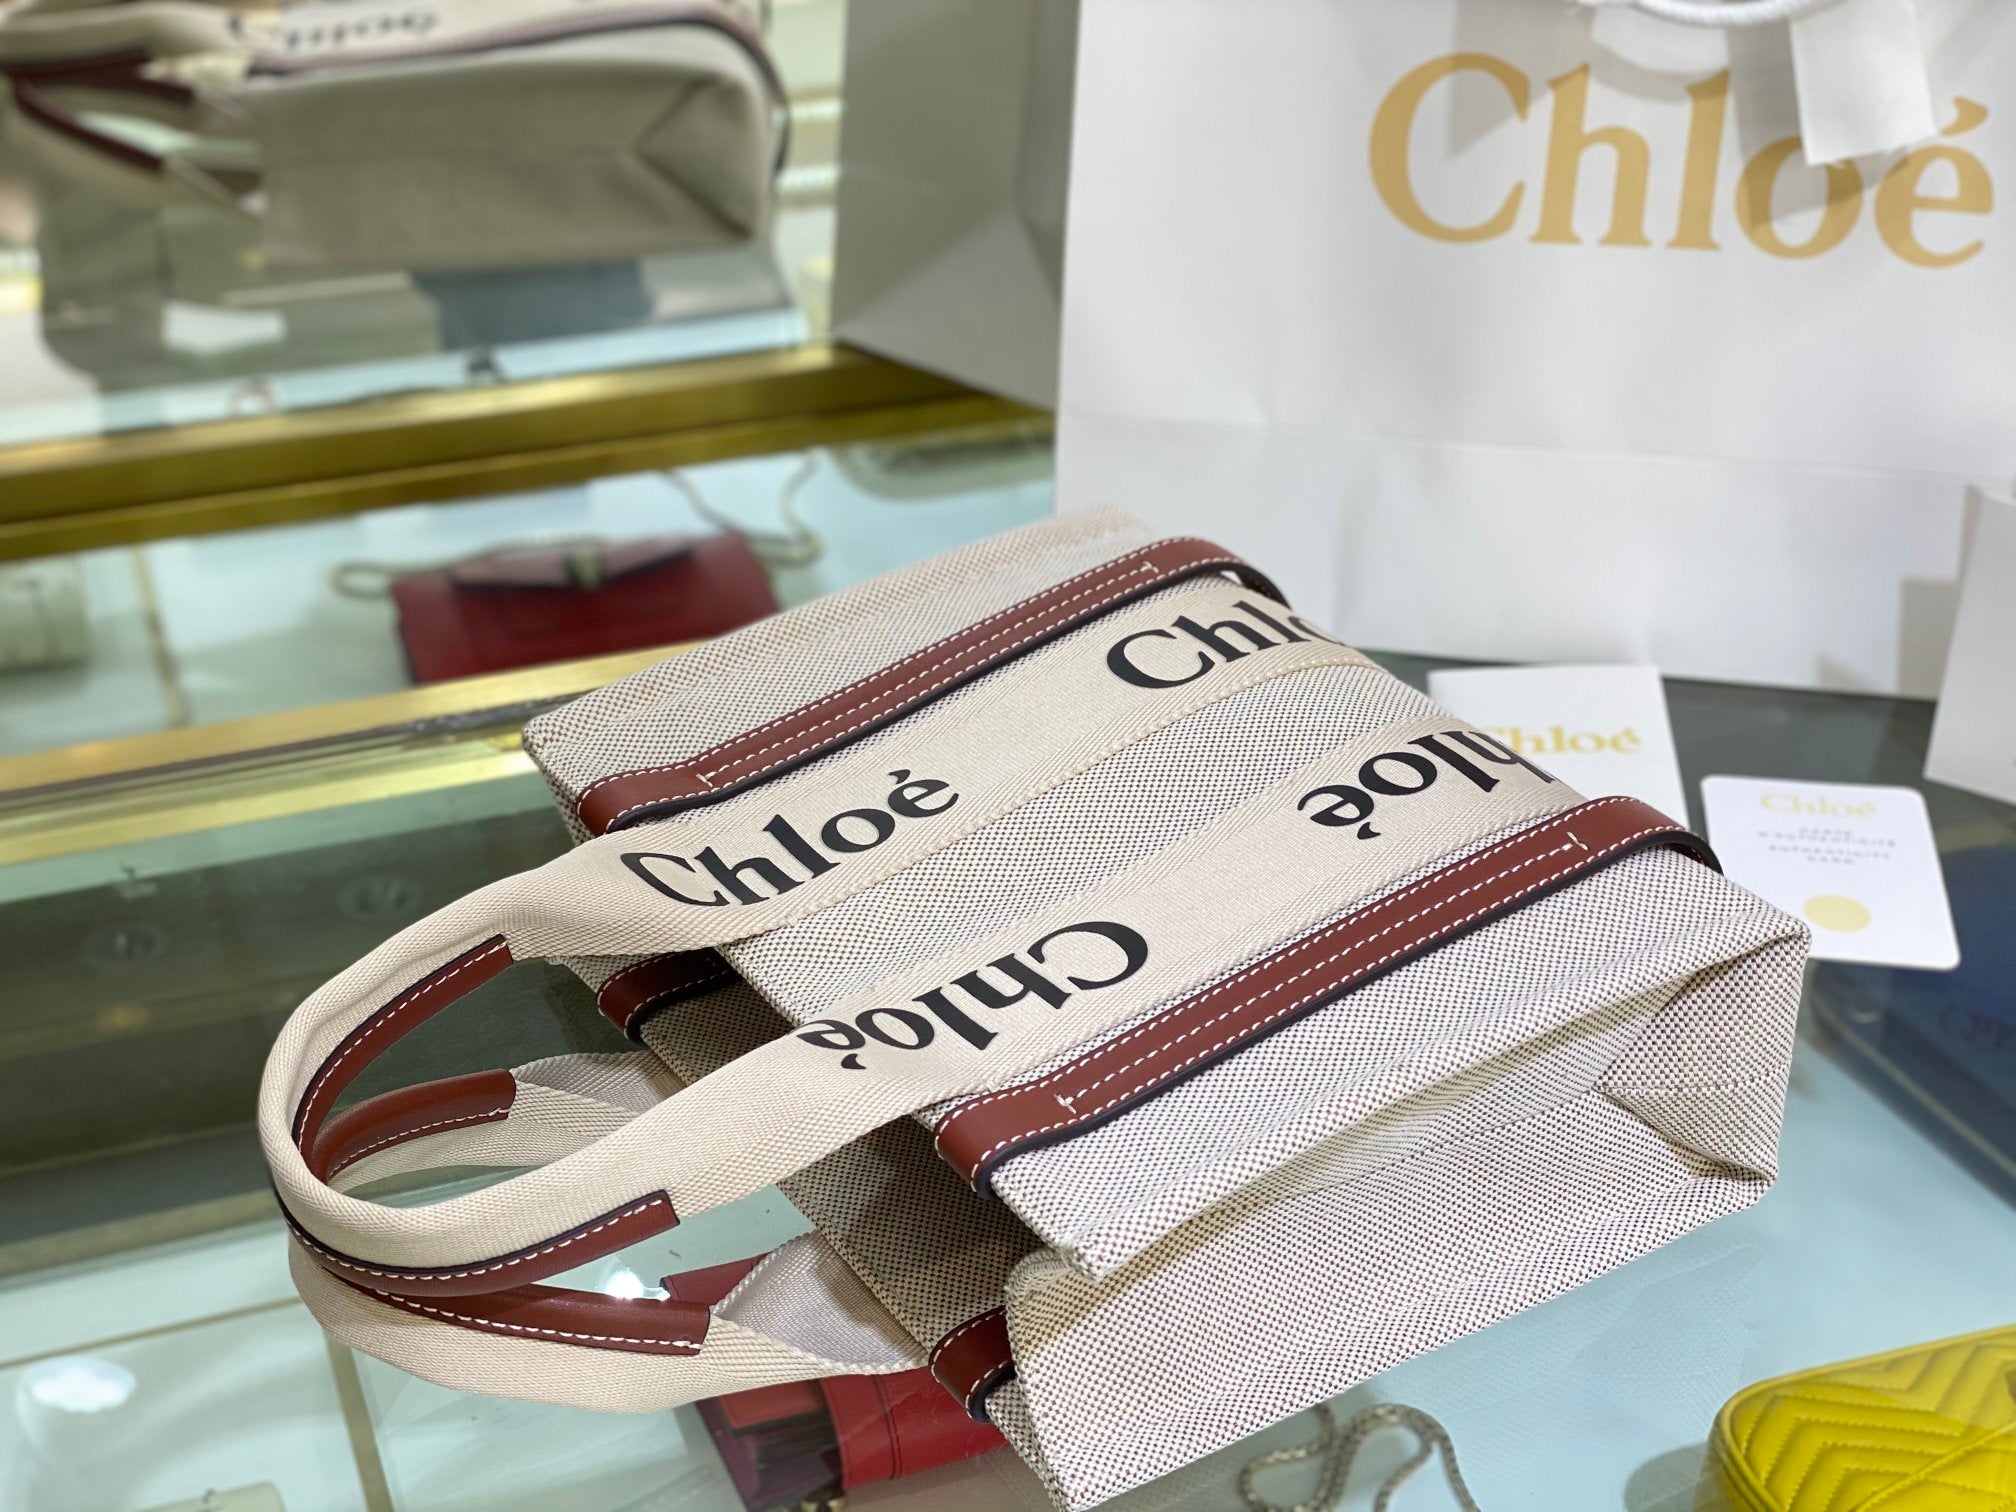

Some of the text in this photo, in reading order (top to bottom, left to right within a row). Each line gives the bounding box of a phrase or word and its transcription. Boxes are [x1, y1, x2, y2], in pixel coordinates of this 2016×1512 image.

[1369, 52, 1994, 268] Chloé
[620, 769, 959, 907] Chloé
[796, 921, 1149, 1070] Chloé
